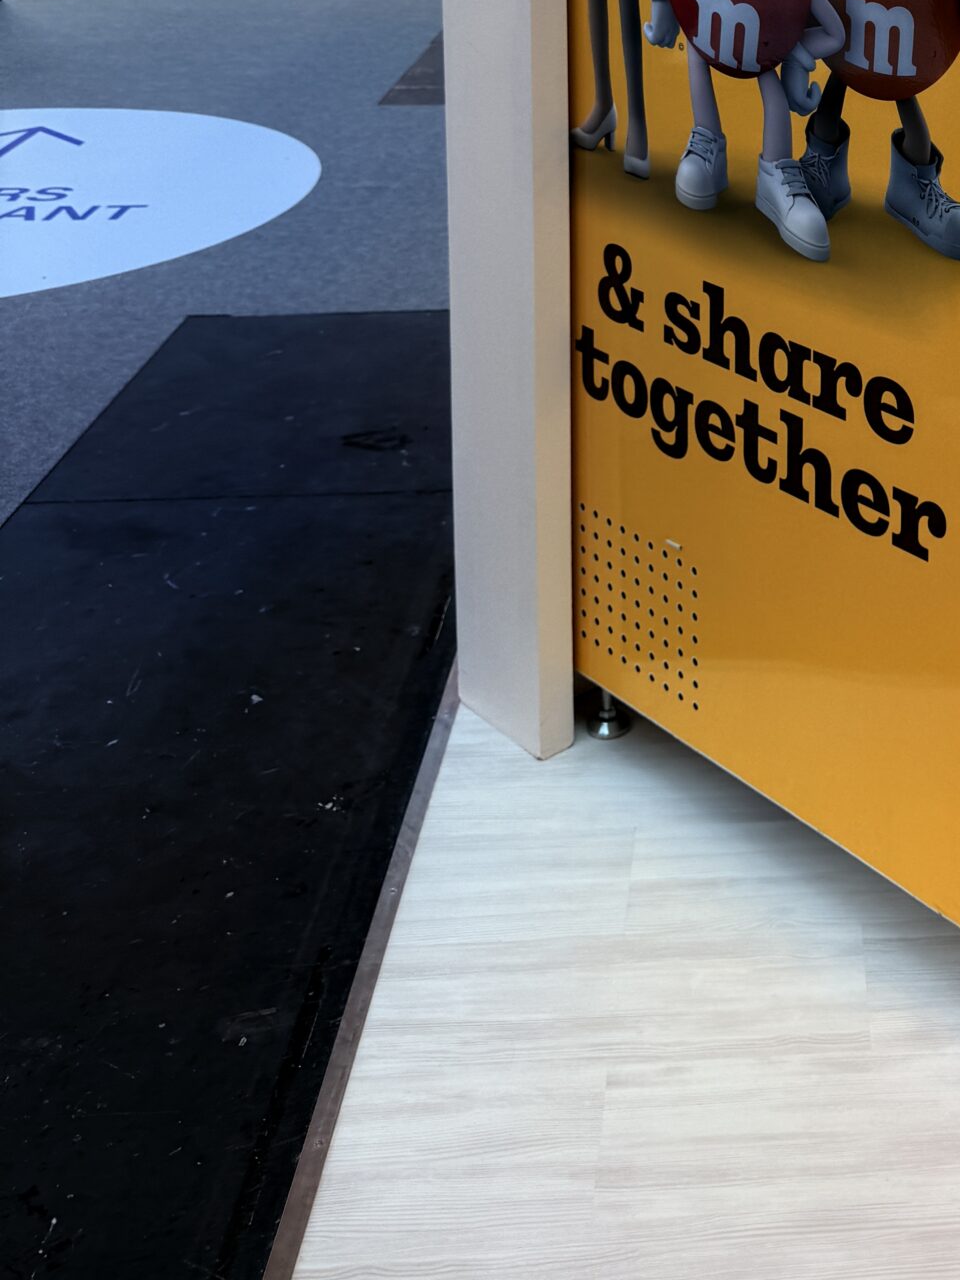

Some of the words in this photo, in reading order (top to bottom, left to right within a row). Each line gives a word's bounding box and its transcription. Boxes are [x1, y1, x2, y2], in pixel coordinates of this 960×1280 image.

[575, 325, 947, 562] together
[598, 243, 645, 333] &
[664, 281, 915, 445] share
